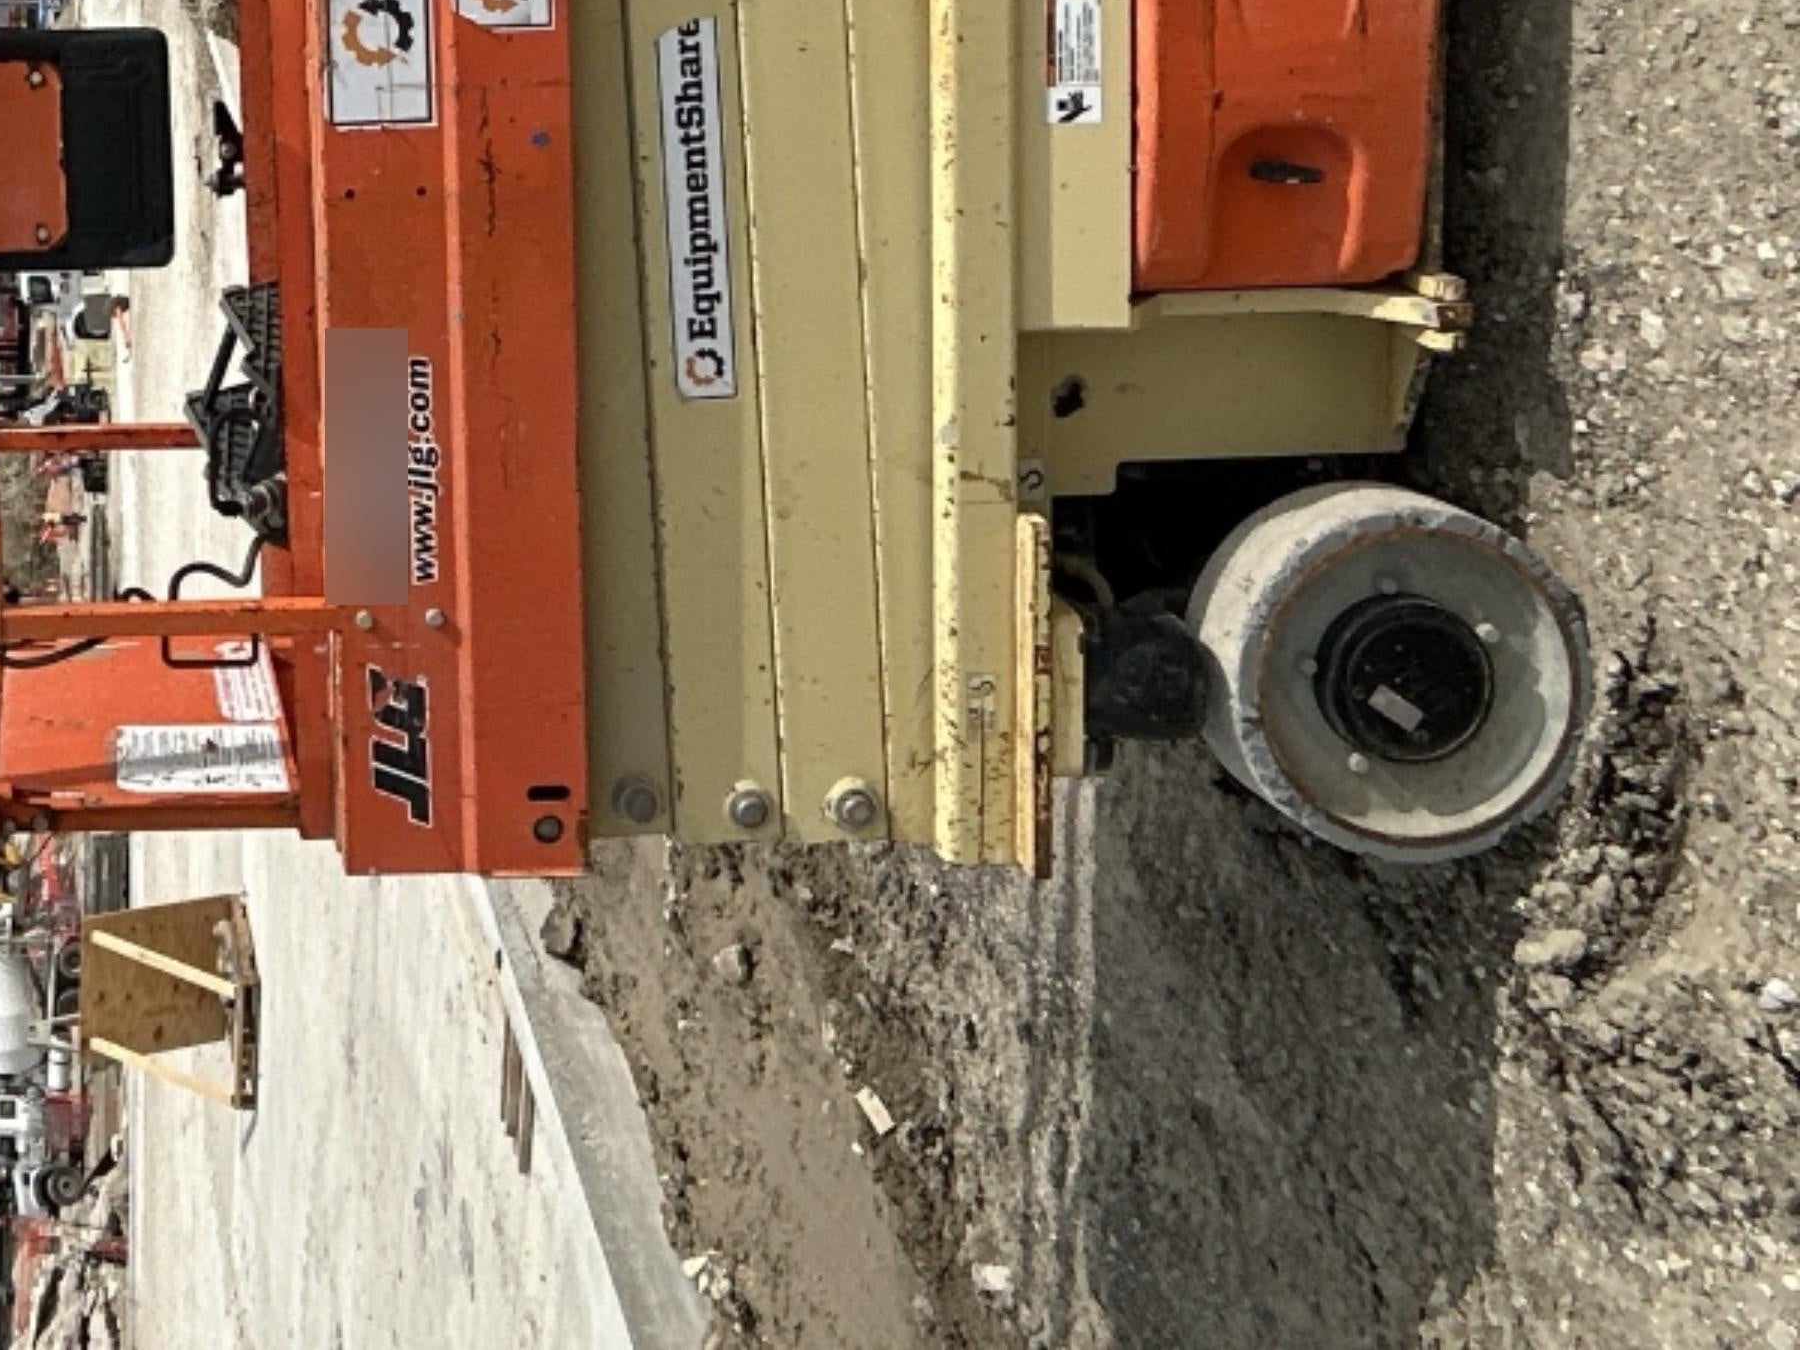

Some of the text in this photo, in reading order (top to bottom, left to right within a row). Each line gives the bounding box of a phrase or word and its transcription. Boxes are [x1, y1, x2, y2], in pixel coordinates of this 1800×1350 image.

[674, 18, 720, 341] EquipmentShare
[408, 357, 441, 584] www.jlg.com
[366, 663, 432, 828] JLG
